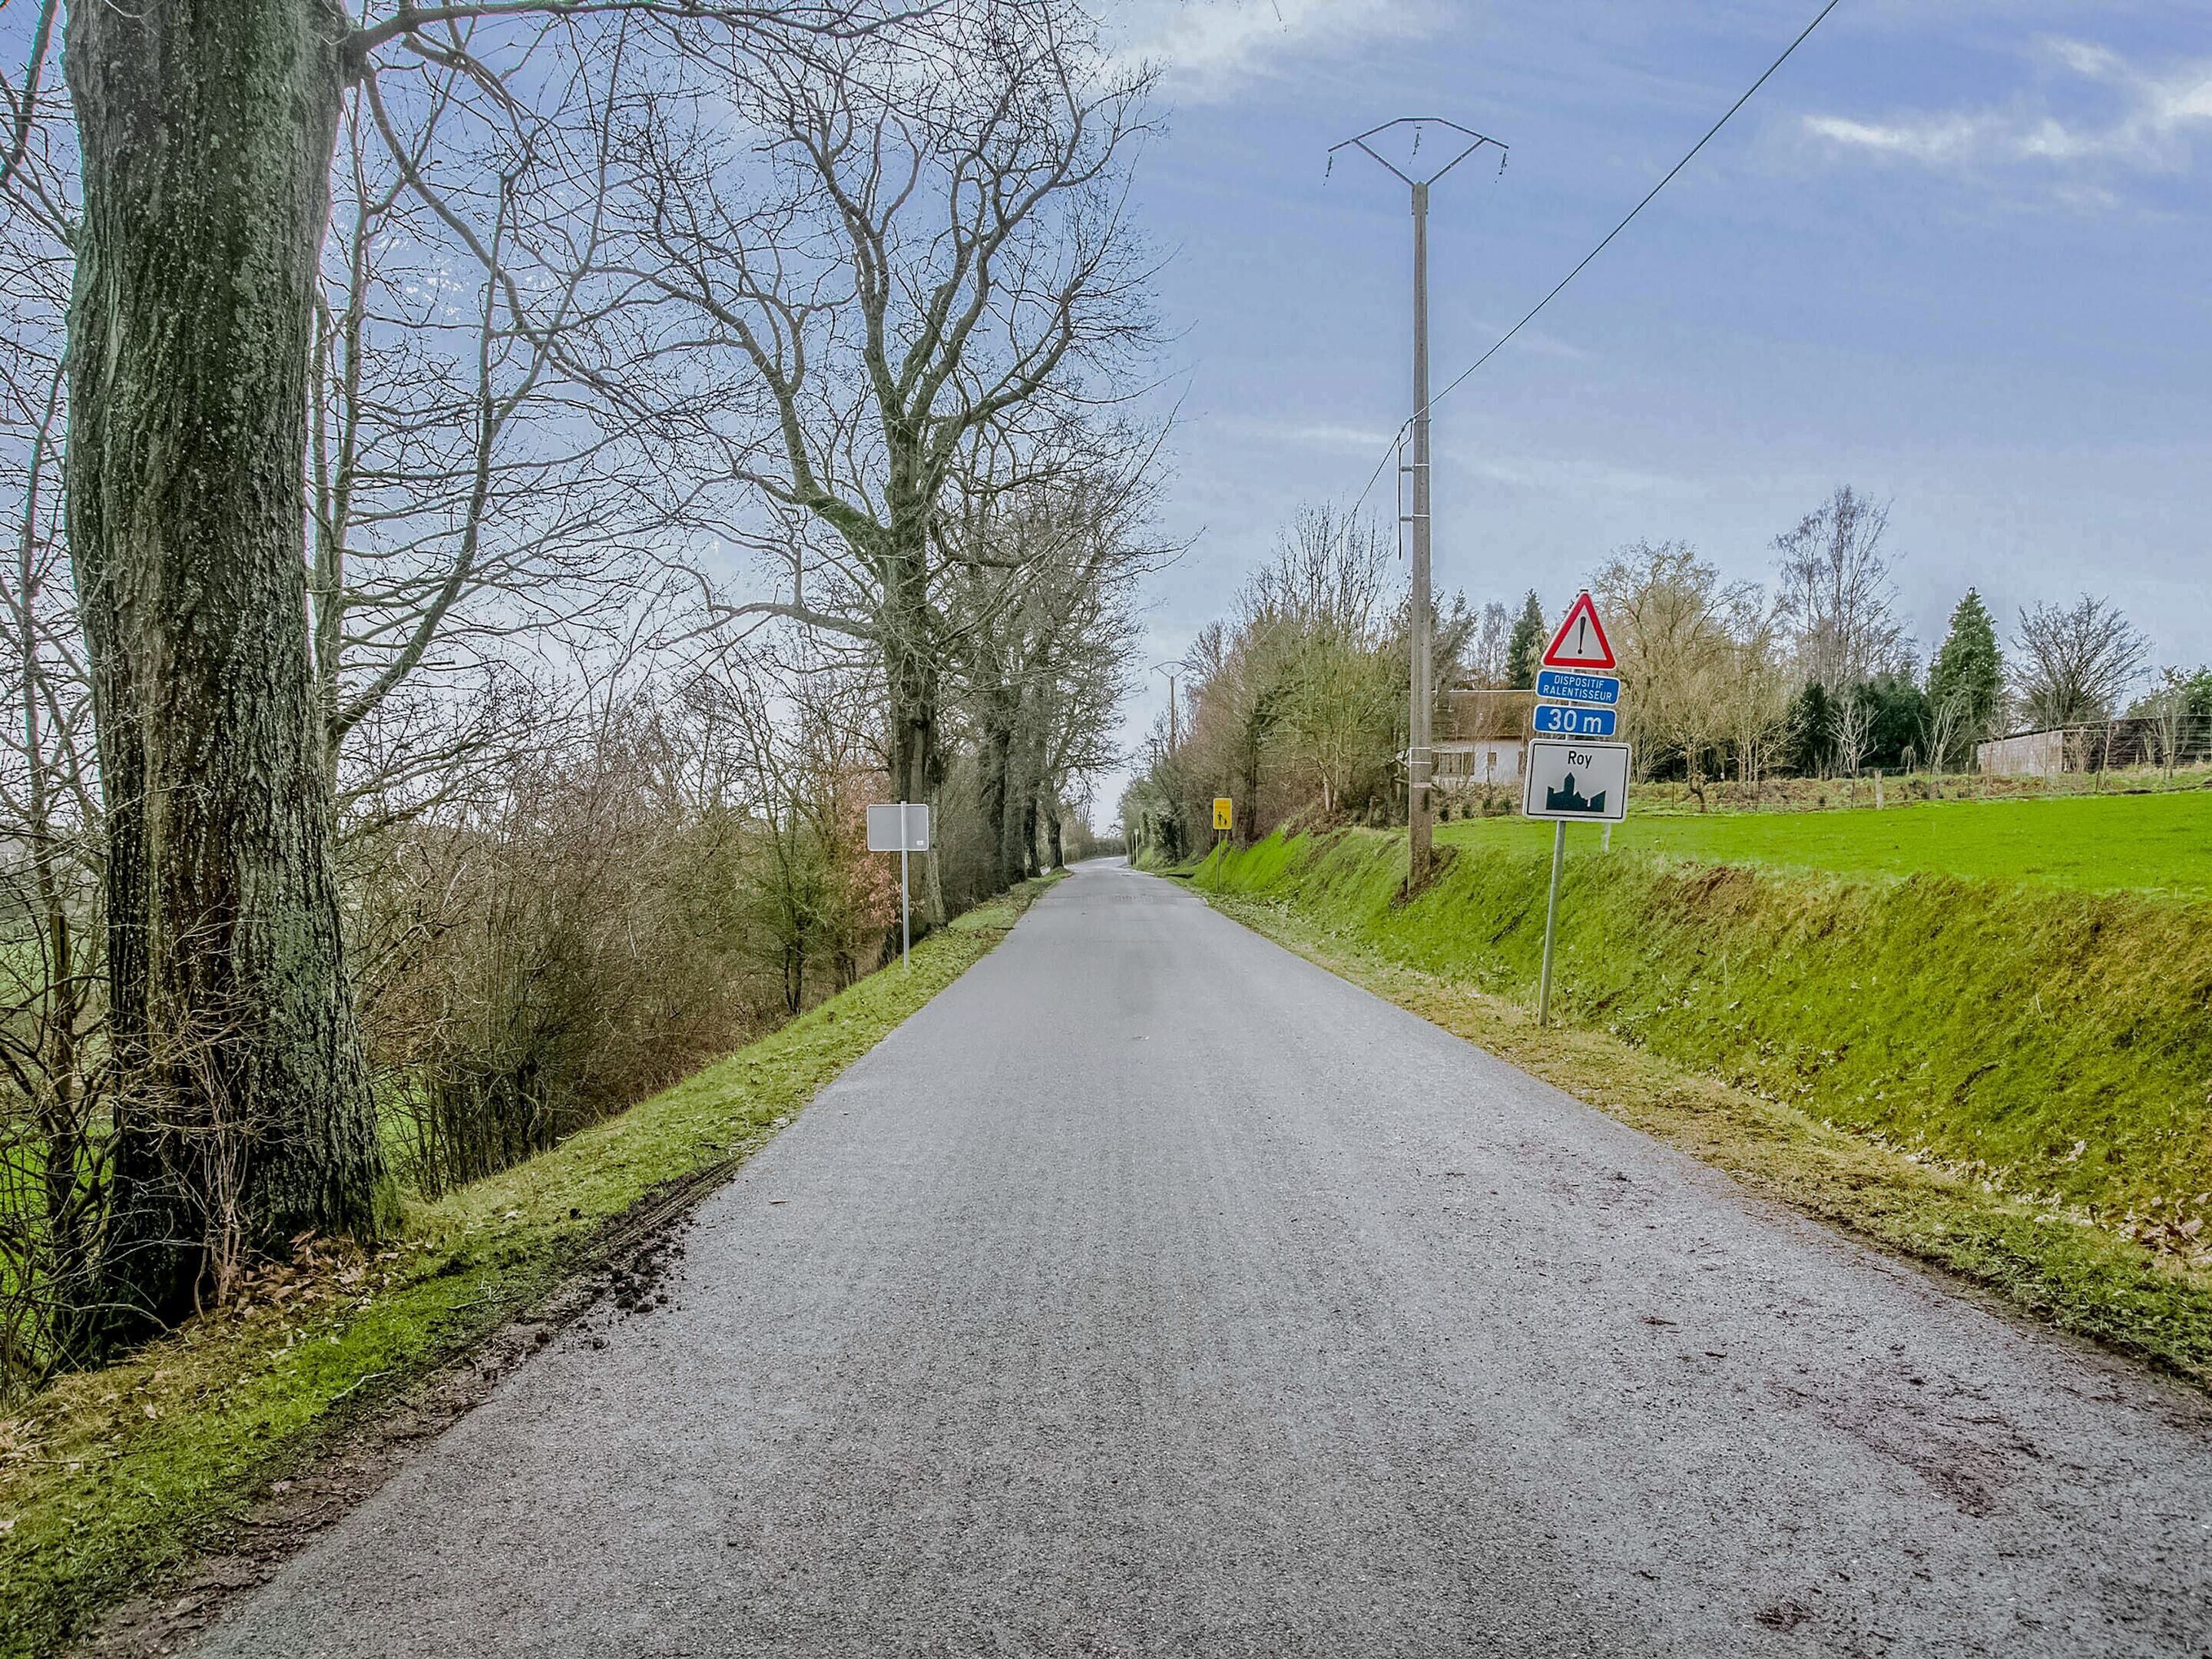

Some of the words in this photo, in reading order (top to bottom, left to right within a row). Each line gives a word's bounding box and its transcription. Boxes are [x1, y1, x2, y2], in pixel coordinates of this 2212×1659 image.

[1554, 674, 1604, 689] DISPOSITIF
[1543, 684, 1612, 701] RALENTISSEUR
[1548, 708, 1578, 732] 30
[1583, 716, 1602, 733] m
[1568, 750, 1593, 769] Roy
